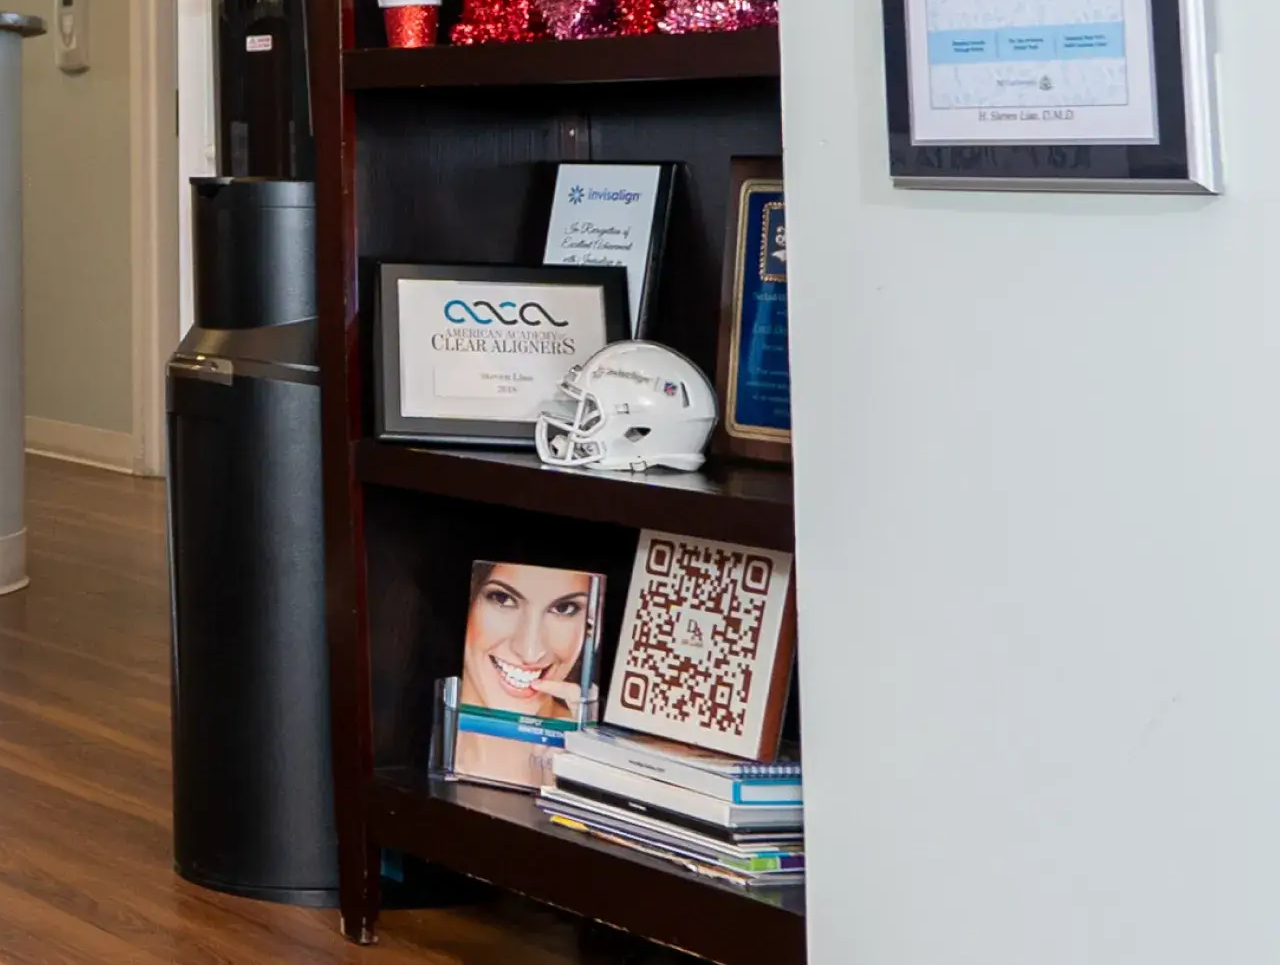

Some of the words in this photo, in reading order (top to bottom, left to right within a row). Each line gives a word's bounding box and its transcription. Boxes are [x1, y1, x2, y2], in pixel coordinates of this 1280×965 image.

[588, 188, 640, 204] invisalign
[432, 333, 487, 353] CLEAR
[491, 337, 576, 356] ALIGNERS
